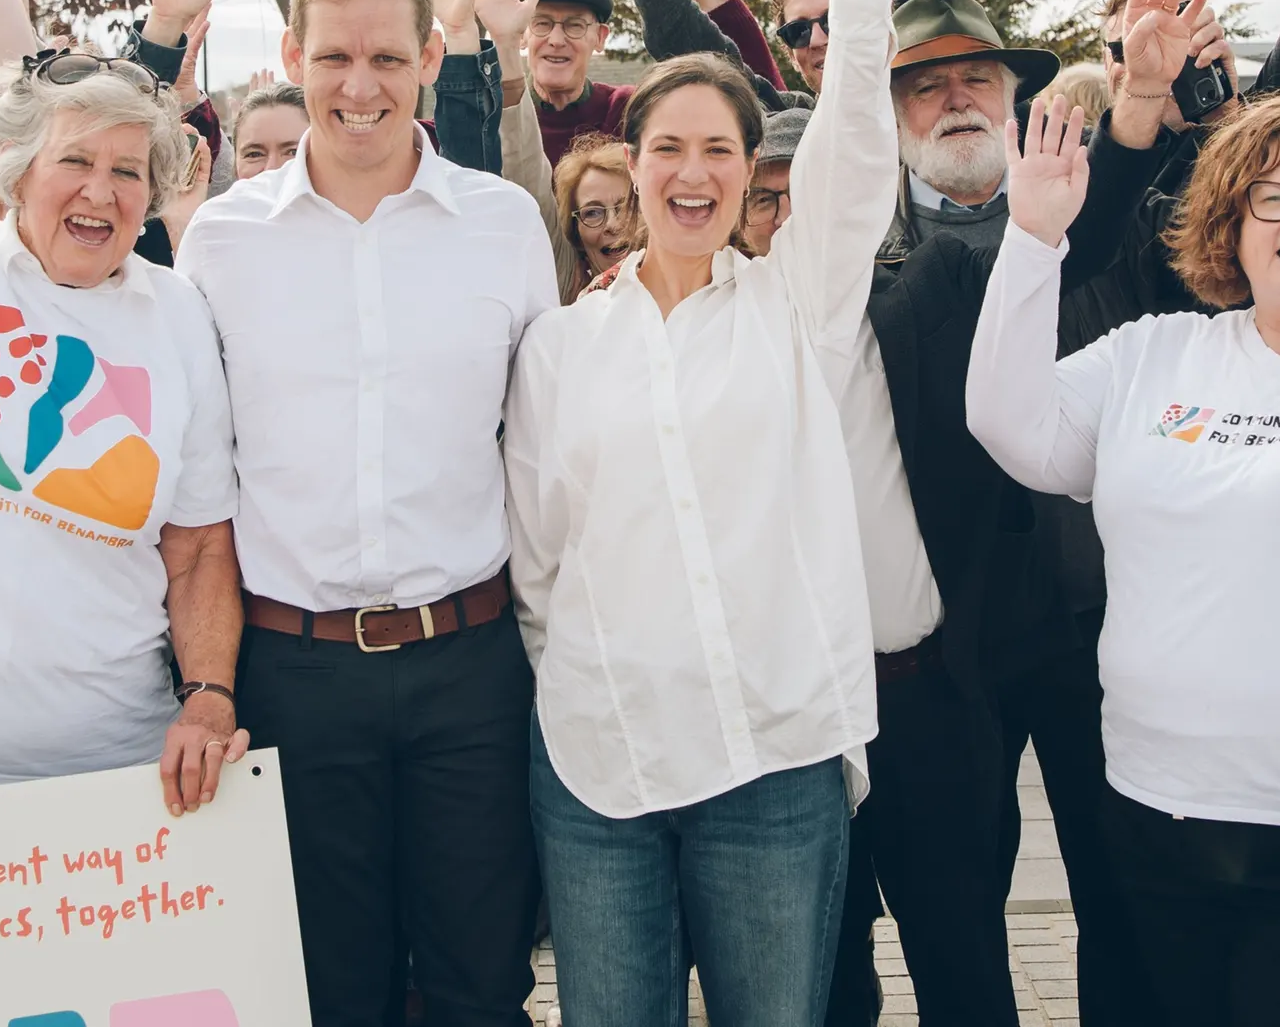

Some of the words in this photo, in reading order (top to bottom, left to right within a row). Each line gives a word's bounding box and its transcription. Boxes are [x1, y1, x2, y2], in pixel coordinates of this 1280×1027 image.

[23, 506, 53, 524] FOR
[57, 519, 135, 548] BENAMBRA
[63, 848, 124, 886] way
[136, 827, 171, 863] of
[55, 881, 224, 939] together.
